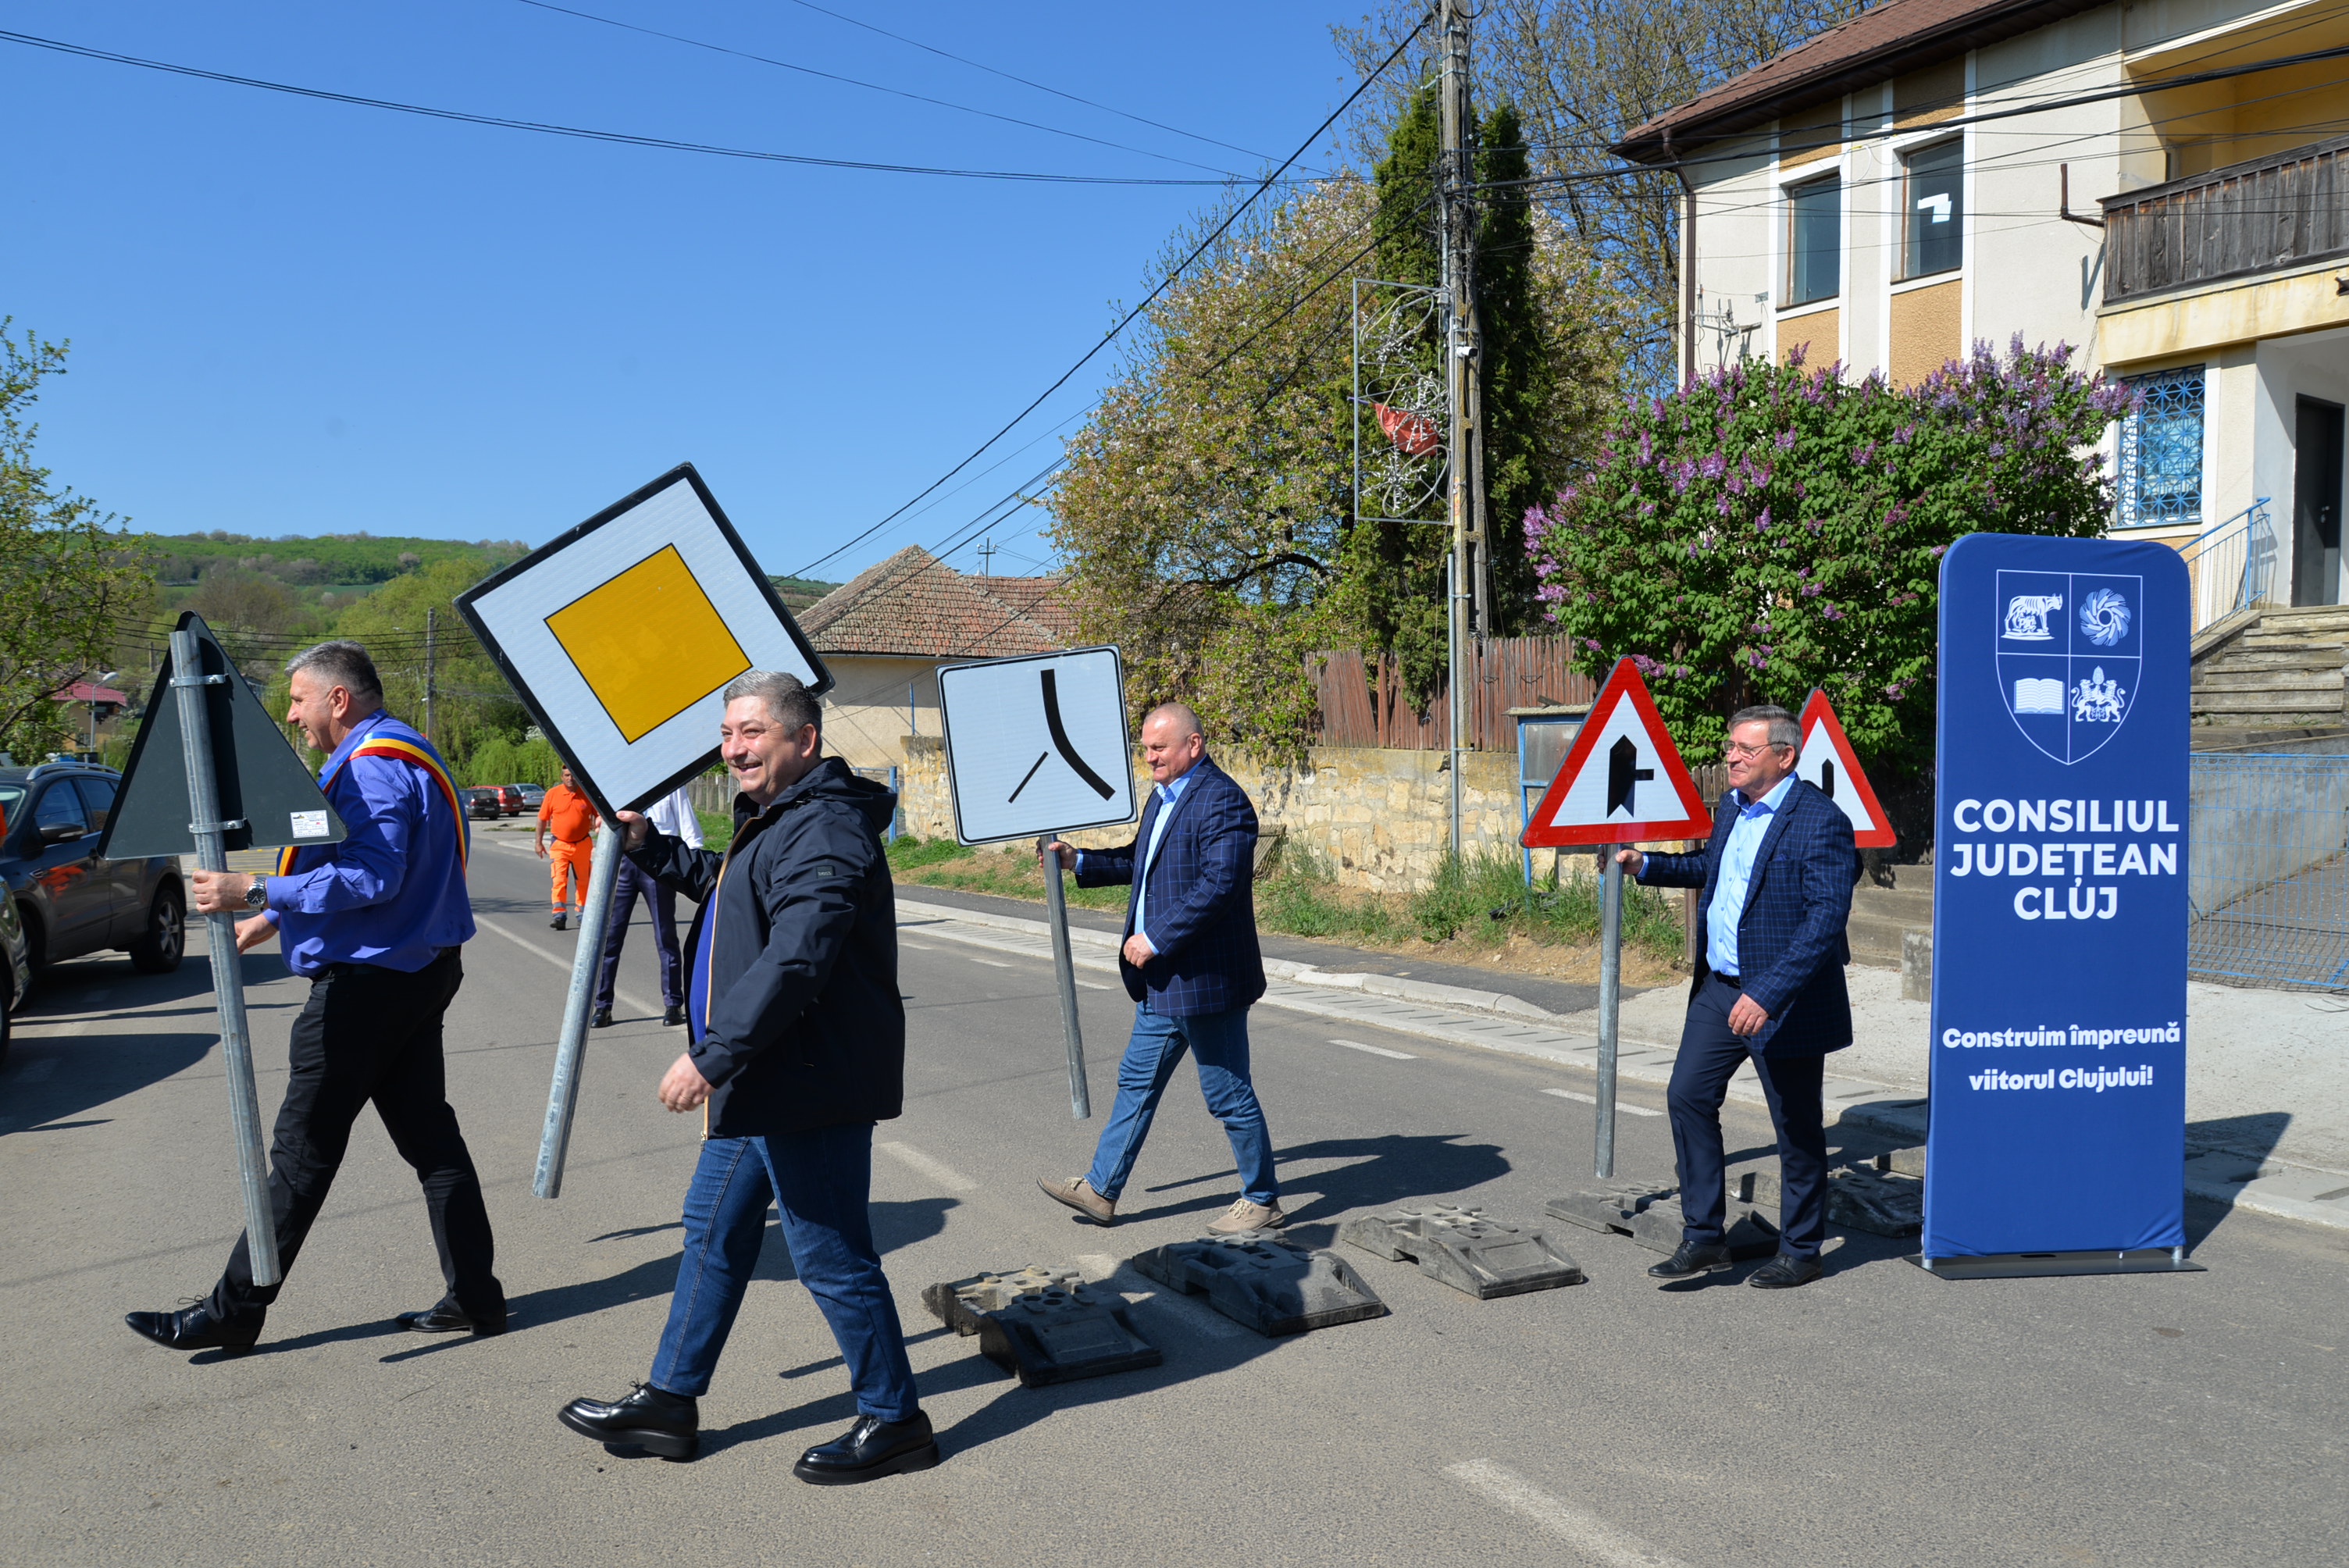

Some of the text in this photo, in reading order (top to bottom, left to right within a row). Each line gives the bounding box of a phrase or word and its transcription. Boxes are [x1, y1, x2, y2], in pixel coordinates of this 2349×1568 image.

[1953, 799, 2180, 832] CONSILIUL
[1950, 843, 2177, 887] JUDEȚEAN
[2013, 886, 2118, 921] CLUJ
[1942, 1021, 2180, 1050] Construim împreună
[1969, 1064, 2153, 1093] viitorul Clujului!
